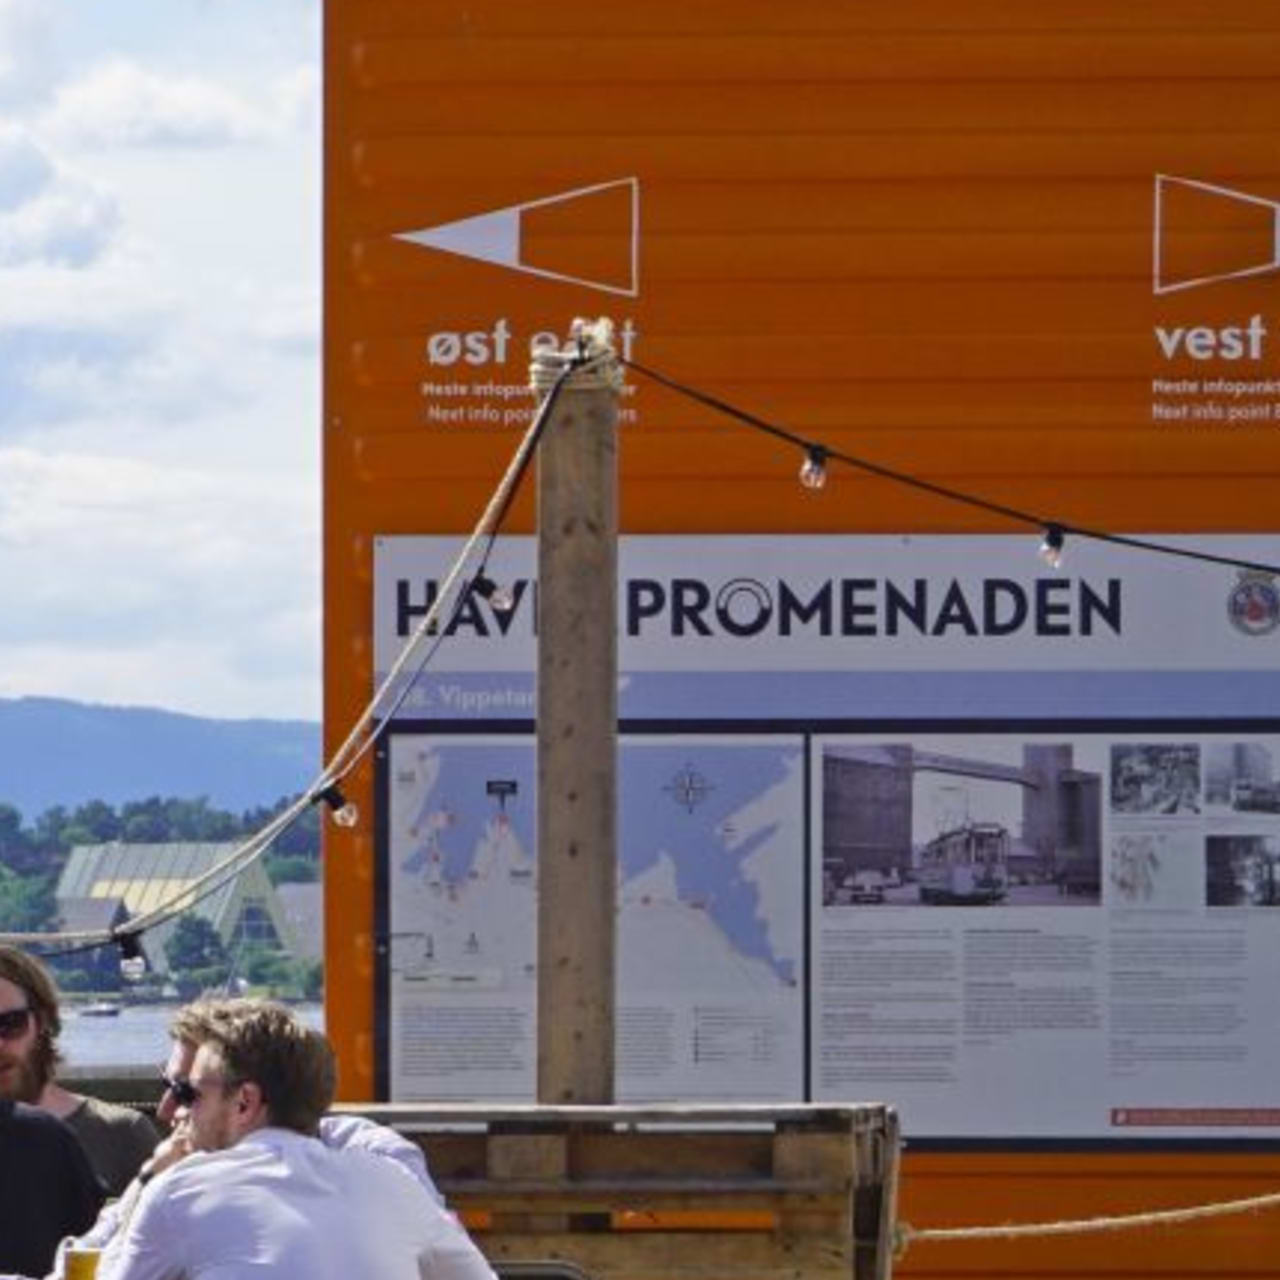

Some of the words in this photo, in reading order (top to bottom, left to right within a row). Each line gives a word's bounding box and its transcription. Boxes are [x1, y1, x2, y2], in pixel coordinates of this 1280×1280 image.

[427, 319, 511, 366] øst
[1154, 314, 1267, 361] vest
[1152, 378, 1199, 395] Neste
[428, 403, 469, 421] Next
[471, 402, 500, 420] info
[1152, 403, 1188, 420] Next
[1193, 401, 1222, 420] info
[1227, 403, 1271, 423] point
